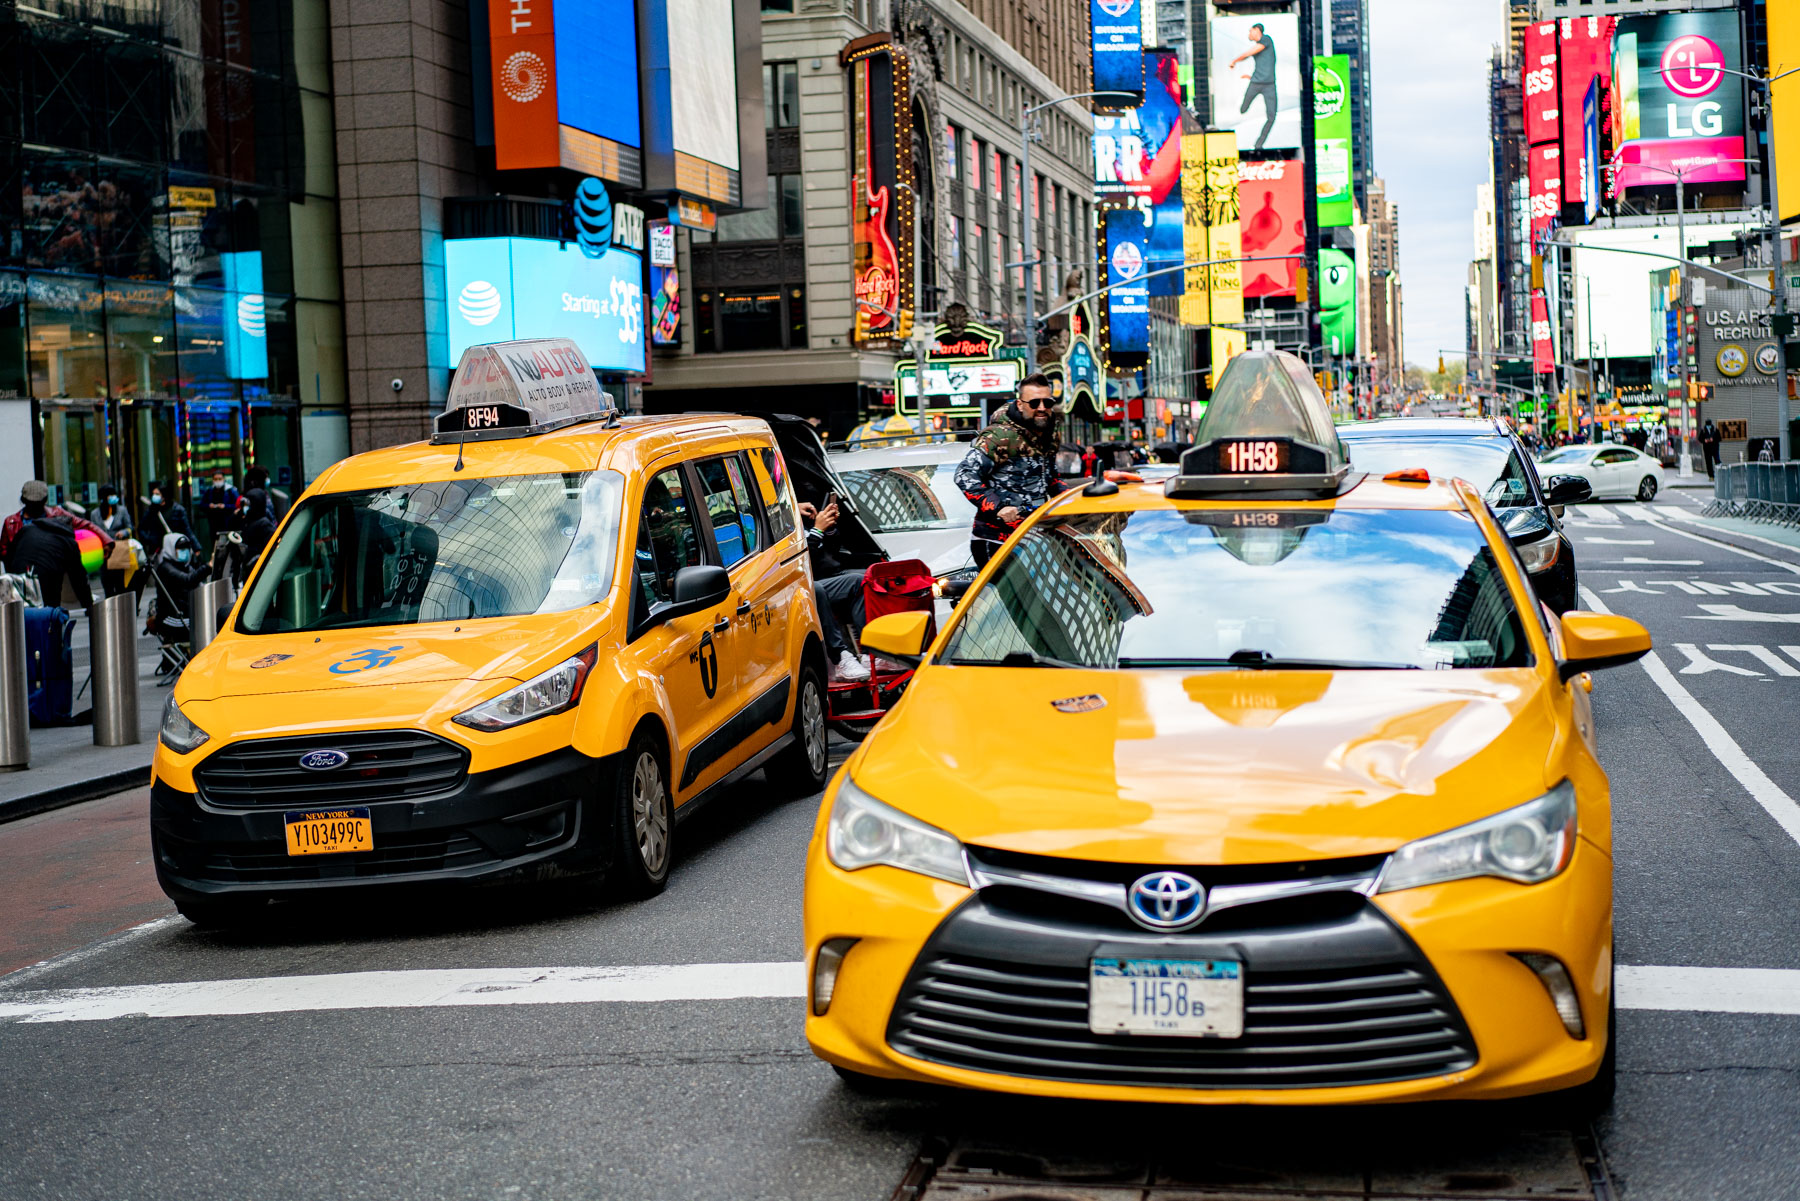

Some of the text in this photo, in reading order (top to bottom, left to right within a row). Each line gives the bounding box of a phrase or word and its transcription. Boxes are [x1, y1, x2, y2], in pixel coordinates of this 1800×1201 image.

[1667, 101, 1723, 138] LG
[653, 237, 672, 249] TACO
[654, 249, 672, 261] BELL
[855, 274, 895, 296] Hard Rock
[1212, 276, 1240, 291] KING
[561, 292, 600, 318] Starting
[600, 299, 609, 315] at
[1705, 310, 1734, 325] U.S.
[1714, 327, 1798, 340] RECRUITG
[961, 340, 989, 356] Rock
[1717, 377, 1768, 386] ARMY NAVY
[528, 387, 546, 401] AUTO
[548, 384, 565, 398] BODY
[573, 380, 594, 393] REPAIR
[468, 407, 499, 428] 8F94
[1227, 442, 1278, 471] 1H58
[308, 753, 336, 767] Ford
[305, 810, 349, 821] NEW YORK
[293, 821, 364, 847] Y103499C
[1127, 962, 1205, 979] NEW YORK
